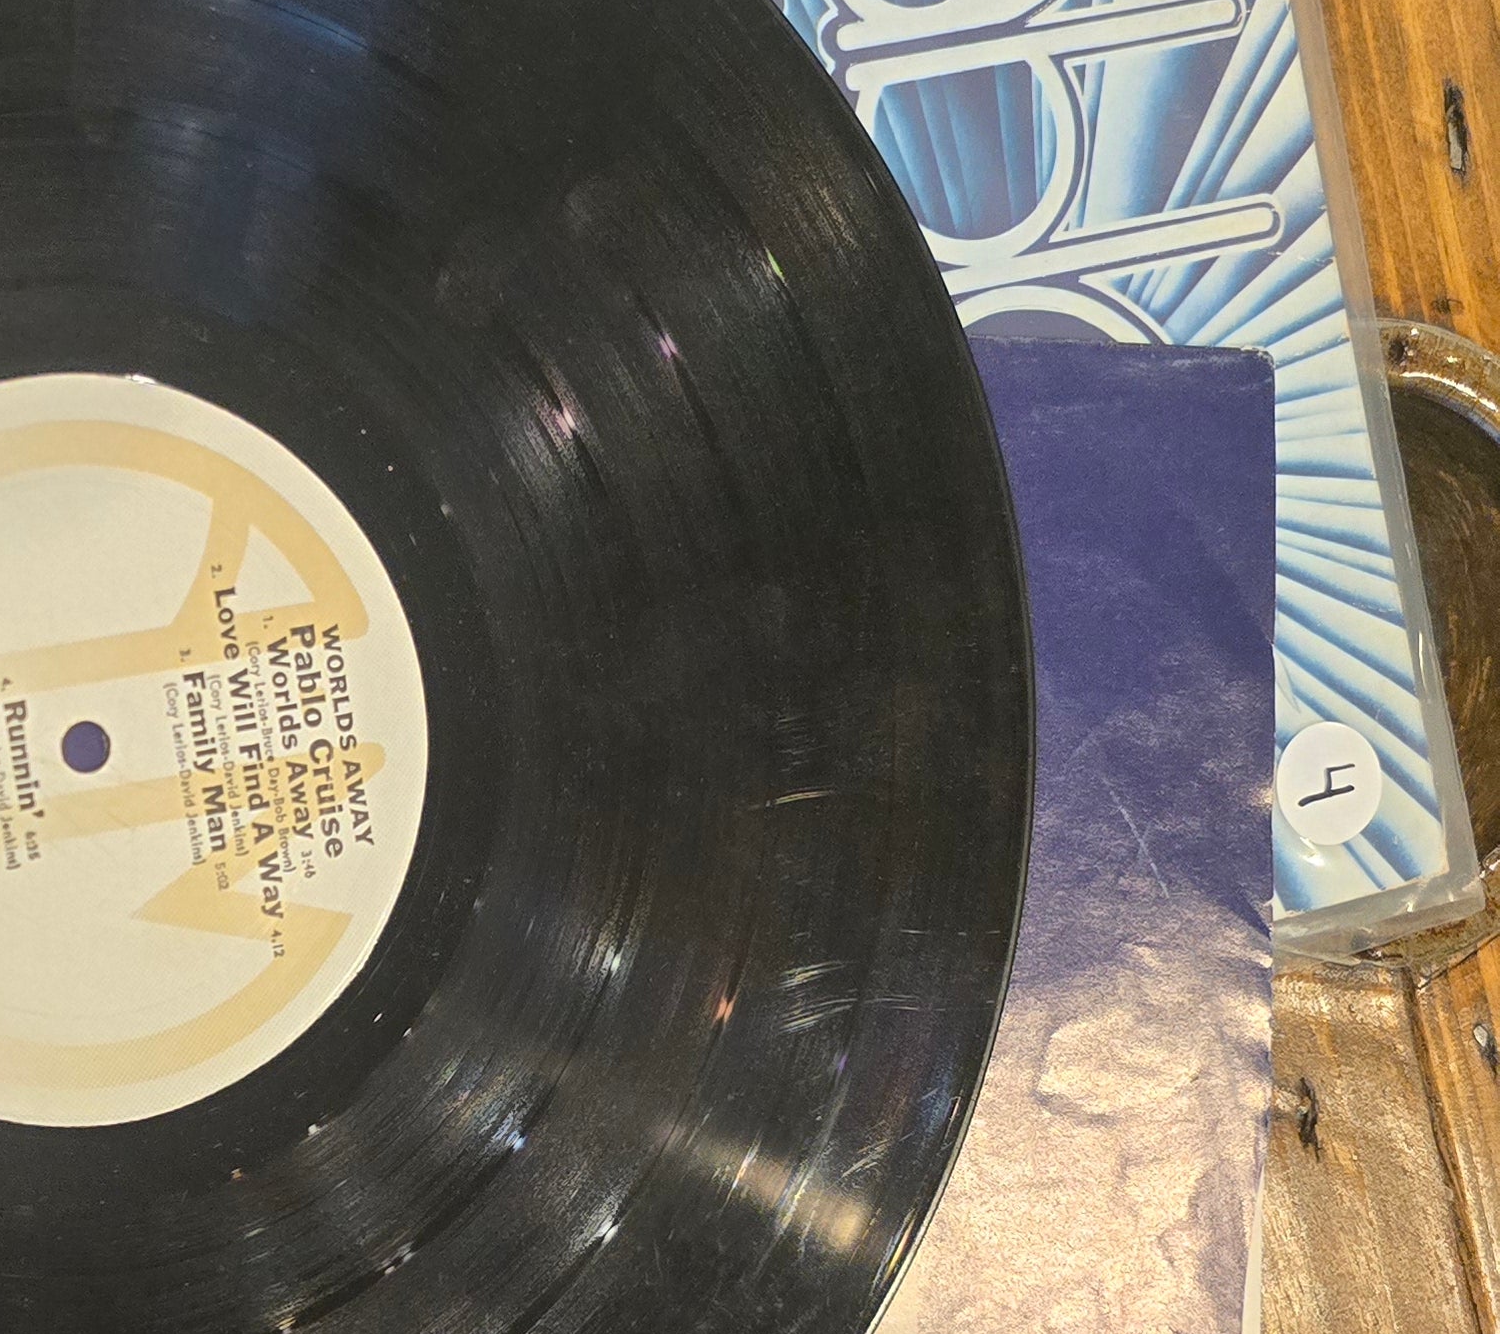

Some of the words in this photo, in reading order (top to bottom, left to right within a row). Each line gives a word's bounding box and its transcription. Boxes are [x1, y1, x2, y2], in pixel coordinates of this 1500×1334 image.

[211, 565, 222, 578] 2.
[215, 587, 242, 660] Love
[3, 700, 44, 818] Runnin'
[228, 669, 259, 733] Will
[246, 641, 262, 677] (Cory
[276, 827, 295, 873] Brown)
[267, 637, 302, 750] Worlds
[286, 761, 316, 839] Away
[290, 624, 326, 728] Pablo
[309, 738, 345, 858] Cruise
[323, 625, 357, 751] WORLDS
[342, 759, 374, 846] AWAY
[164, 683, 180, 719] (Cory
[184, 812, 206, 866] Jenkins)
[183, 671, 217, 774] Family
[203, 785, 228, 853] Man
[207, 675, 223, 711] (Cory
[228, 804, 248, 856] Jenkins)
[240, 744, 270, 811] Find
[1298, 763, 1355, 807] 4
[252, 822, 274, 843] A
[258, 852, 286, 919] Way
